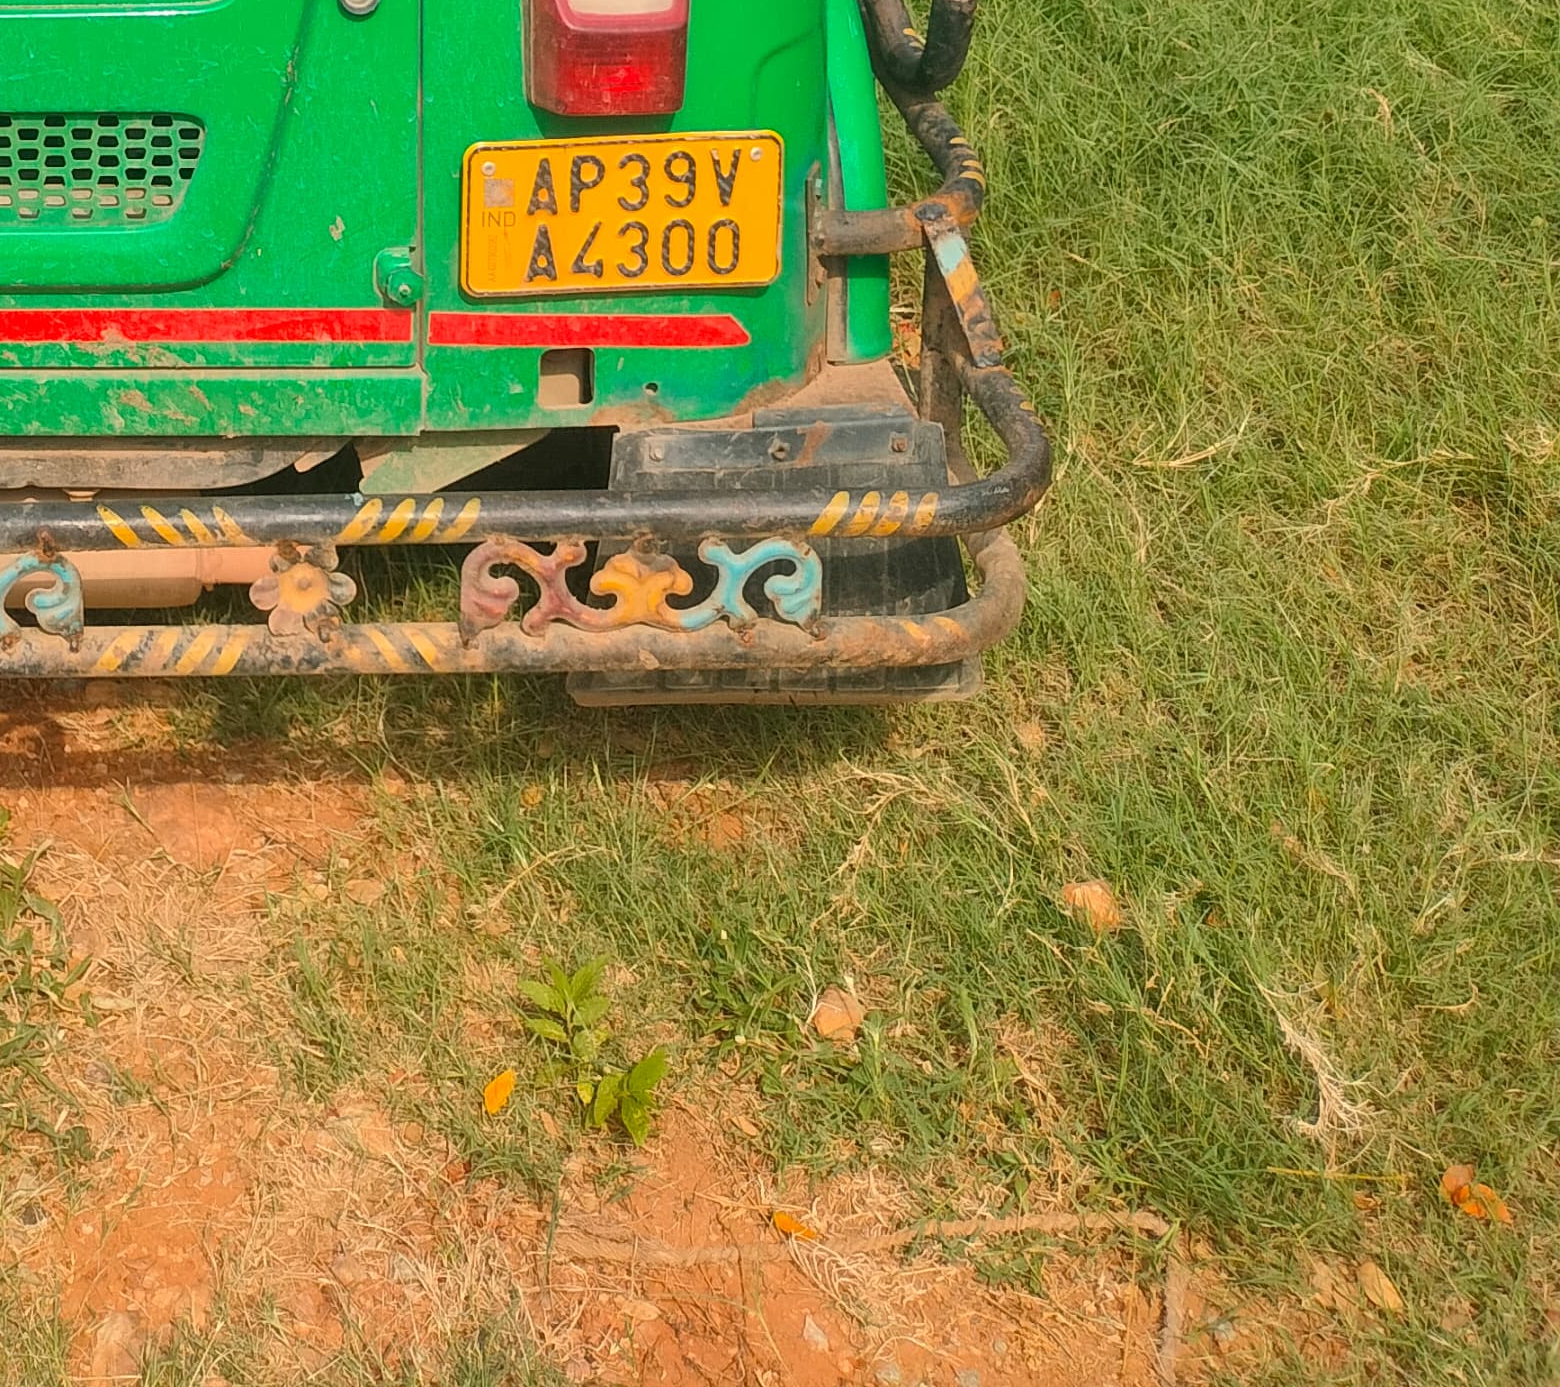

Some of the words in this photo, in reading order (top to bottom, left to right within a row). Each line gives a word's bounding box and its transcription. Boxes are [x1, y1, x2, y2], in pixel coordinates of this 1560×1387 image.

[525, 148, 742, 216] AP39V
[481, 210, 517, 228] IND
[523, 218, 741, 284] A4300
